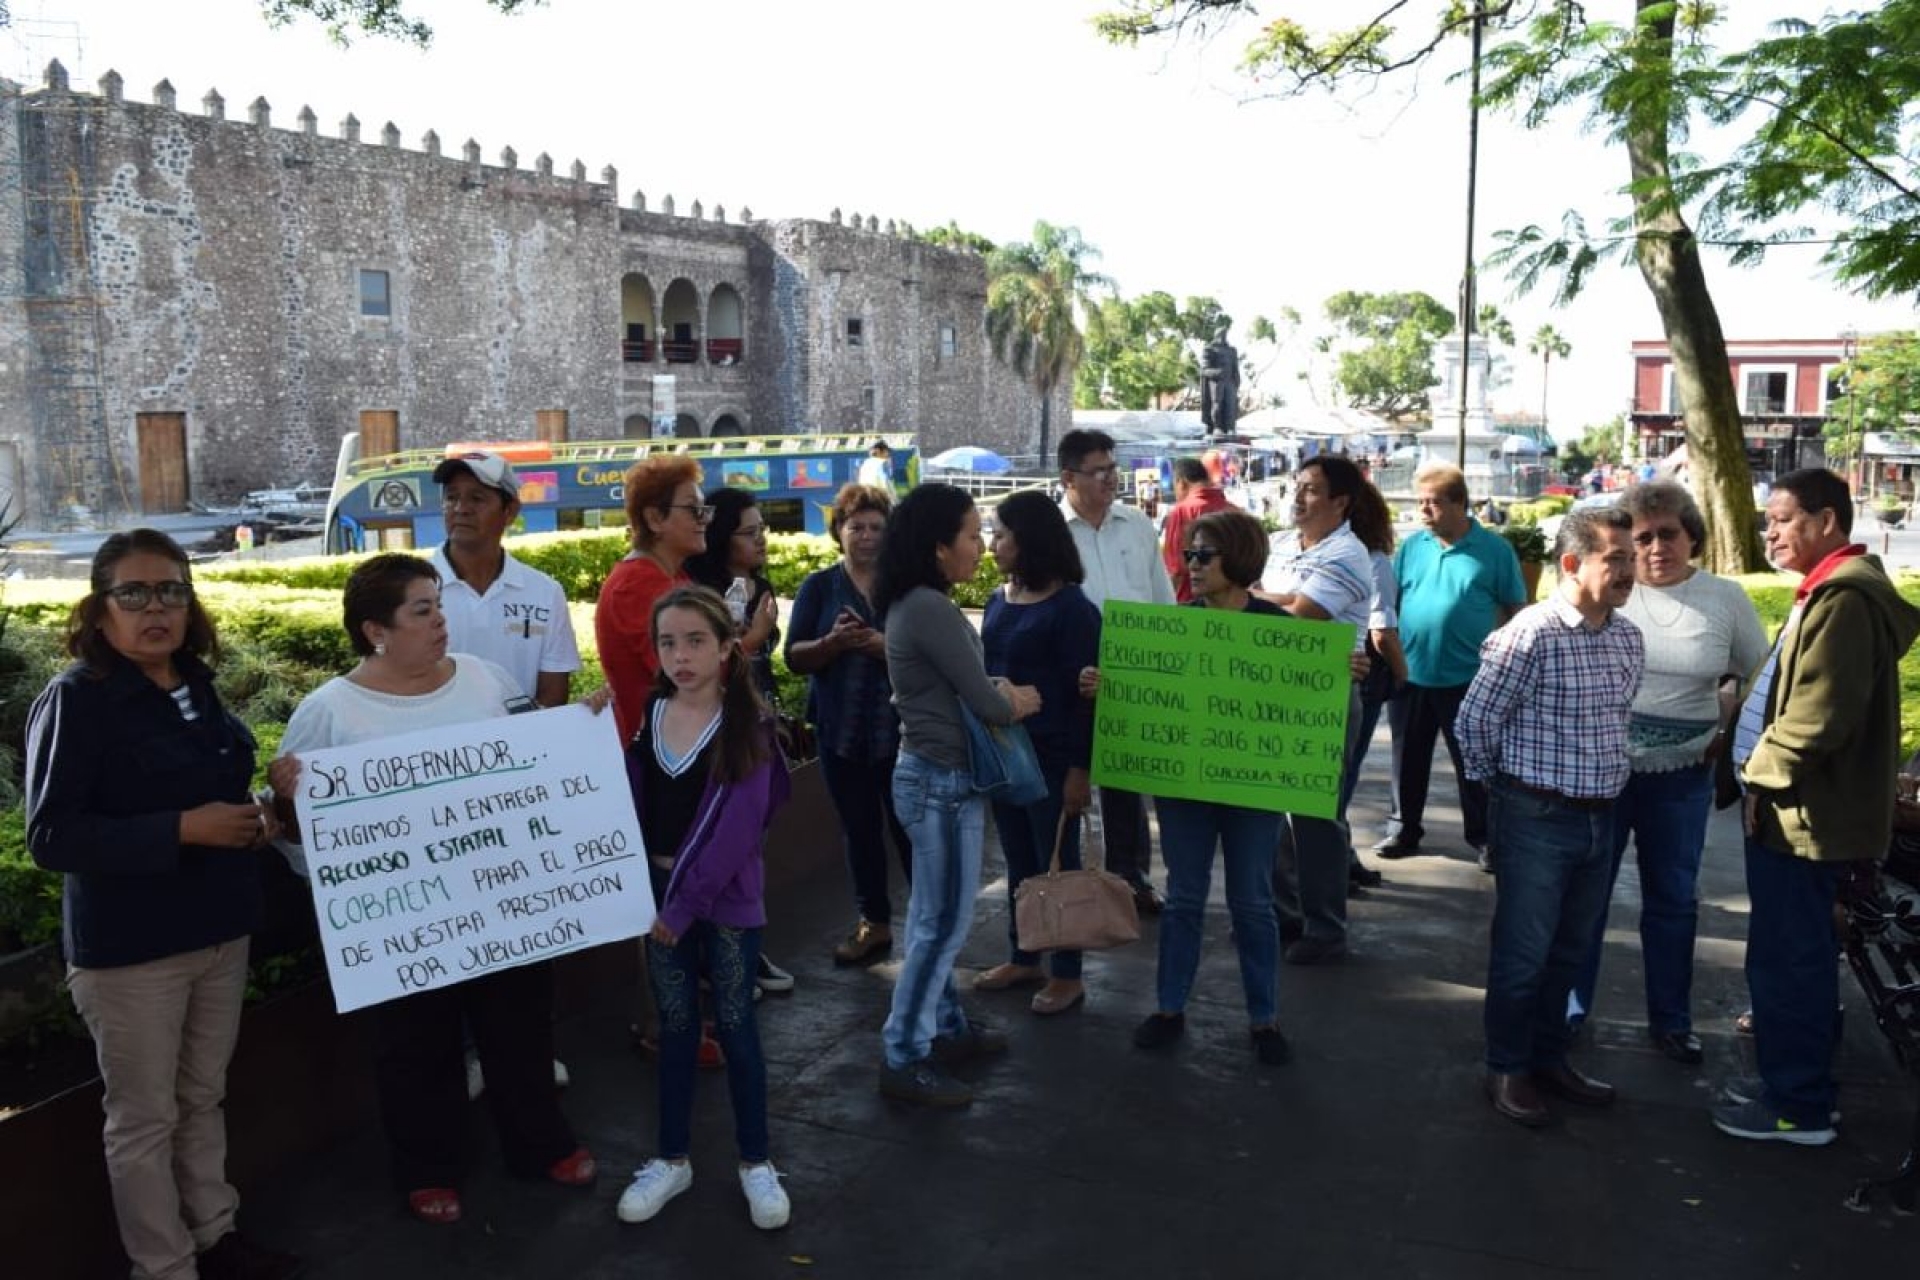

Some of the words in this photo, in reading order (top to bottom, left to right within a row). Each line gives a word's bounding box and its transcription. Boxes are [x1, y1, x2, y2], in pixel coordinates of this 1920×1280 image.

[503, 603, 549, 622] NYC
[1105, 611, 1188, 635] JUBILADOS
[1204, 619, 1235, 642] DEL
[1253, 626, 1326, 655] COBAEM
[1200, 652, 1218, 676] EL
[1229, 657, 1273, 684] PAGO
[1103, 678, 1191, 713] ADICIONAL
[1207, 694, 1244, 720] POR
[1099, 715, 1129, 740] QUE
[1141, 723, 1191, 746] DESDE
[1201, 727, 1248, 751] 2016
[1257, 734, 1283, 756] NO
[1293, 738, 1313, 756] SE
[1103, 750, 1184, 776] CUBIERTO
[311, 815, 411, 852] EXIGIMOS
[431, 804, 459, 827] LA
[464, 785, 550, 821] ENTREGA
[561, 774, 600, 798] DEL
[317, 850, 410, 888] RECURSO
[424, 828, 509, 864] ESTATAL
[528, 815, 562, 840] AL
[328, 875, 451, 930] COBAEM
[472, 858, 530, 892] PARA
[540, 850, 565, 872] EL
[574, 829, 627, 864] PAGO
[341, 941, 373, 967] DE
[383, 910, 486, 956] NUESTRA
[396, 956, 448, 990] POR
